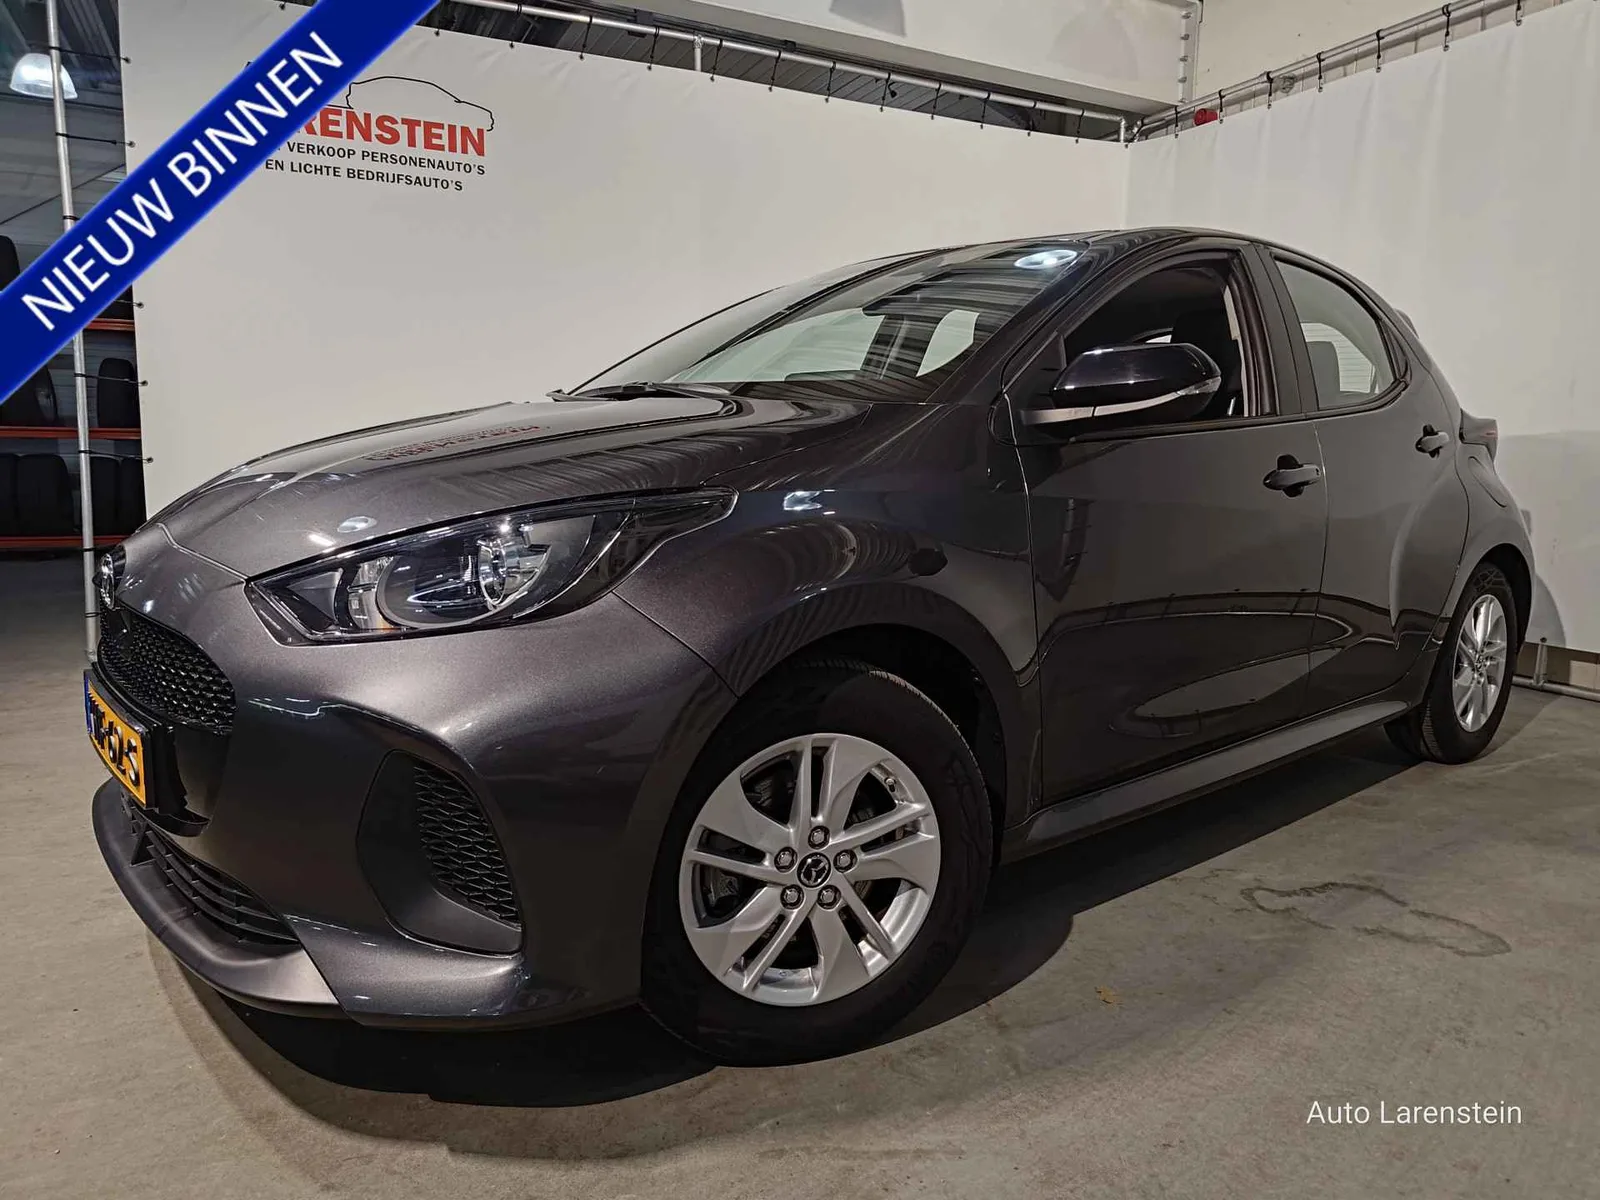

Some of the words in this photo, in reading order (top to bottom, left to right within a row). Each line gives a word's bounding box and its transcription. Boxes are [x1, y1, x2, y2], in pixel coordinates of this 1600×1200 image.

[265, 158, 284, 171] EN
[290, 161, 341, 178] LICHTE
[346, 168, 464, 192] BEDRIJFSAUTO'S
[287, 141, 357, 160] VERKOOP
[361, 150, 486, 176] PERSONENAUTO'S
